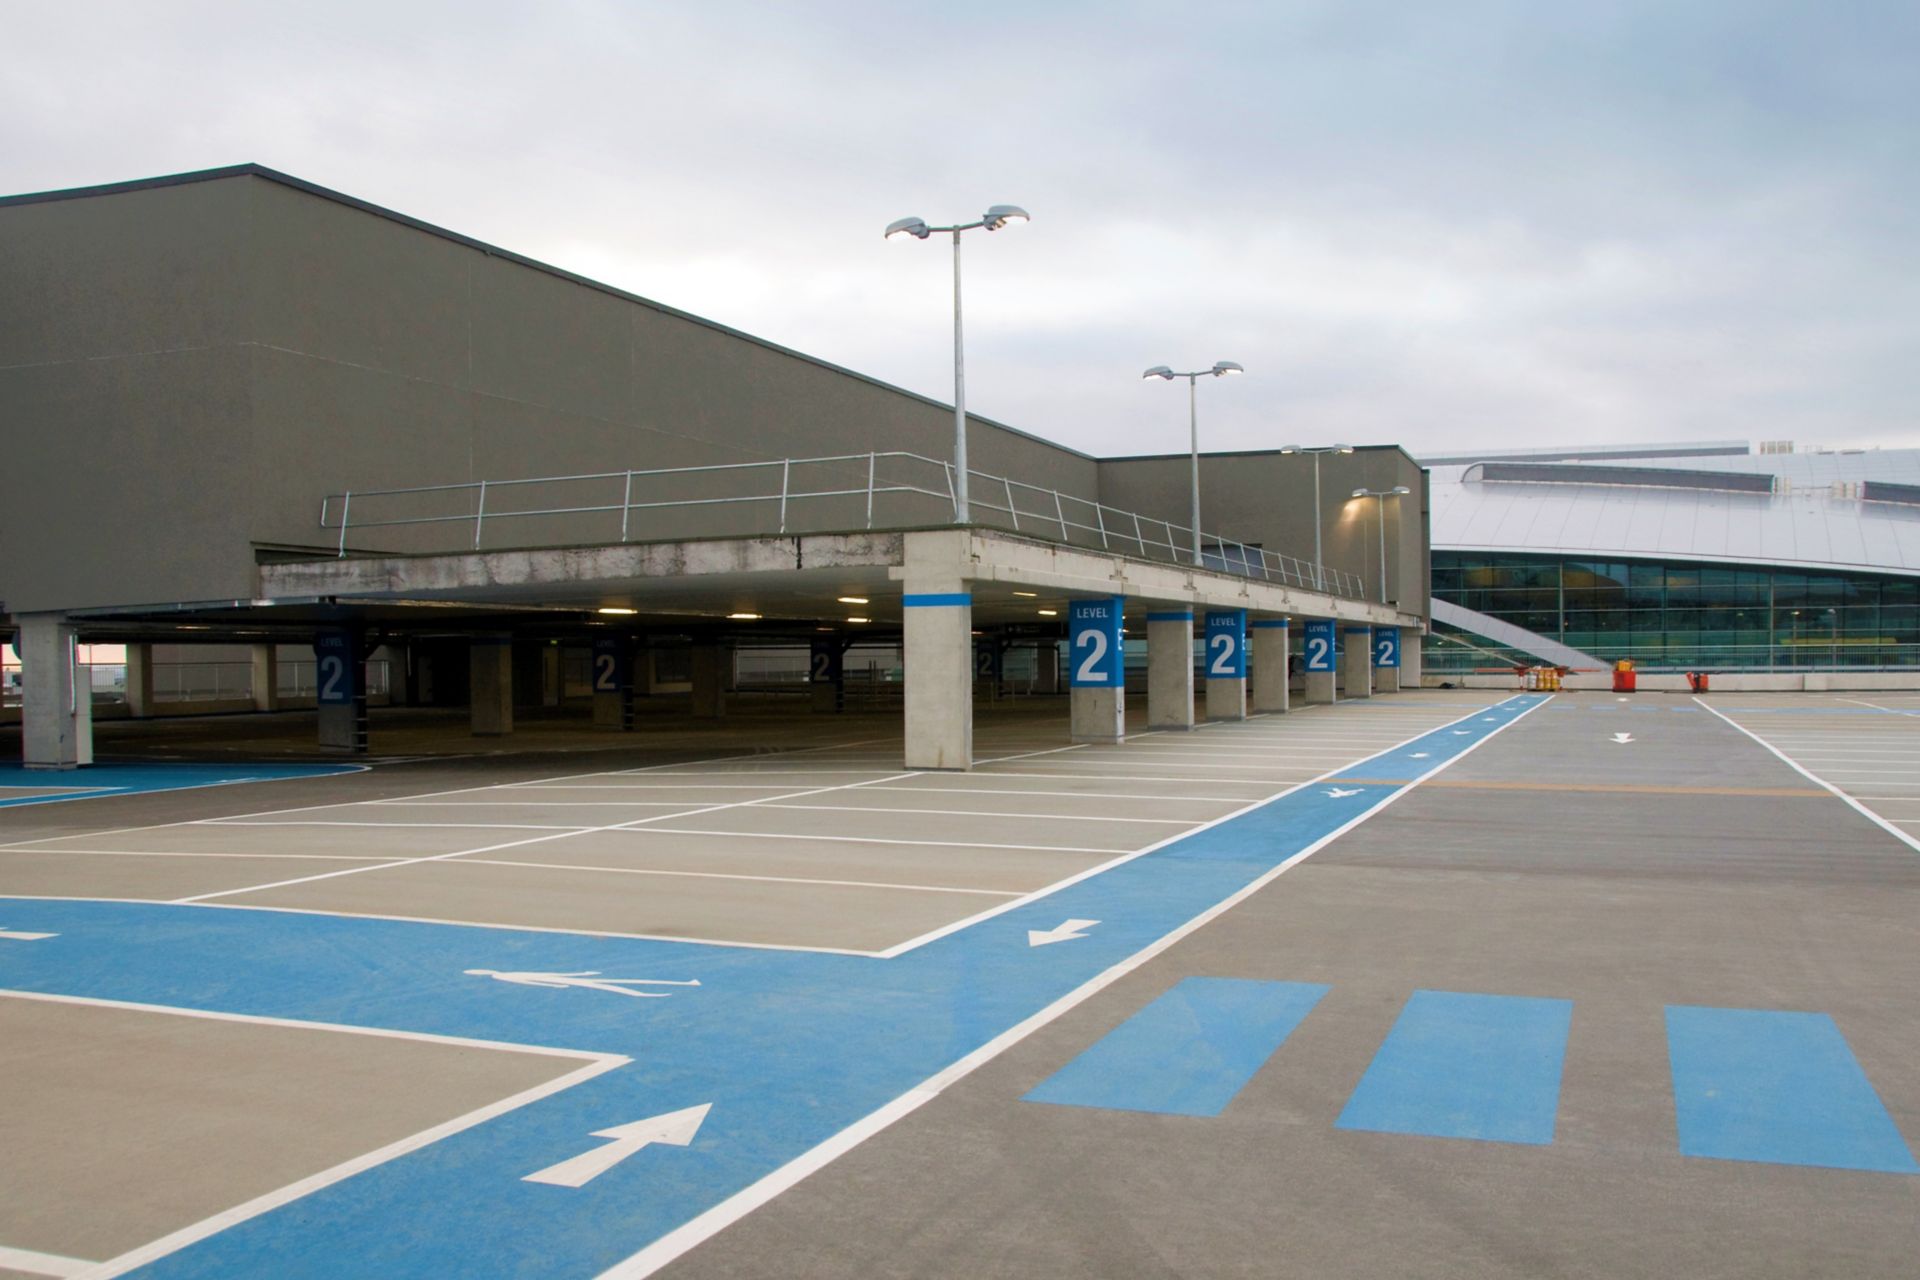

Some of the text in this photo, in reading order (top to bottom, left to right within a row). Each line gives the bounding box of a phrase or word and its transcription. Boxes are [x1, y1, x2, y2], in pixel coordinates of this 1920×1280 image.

[1077, 607, 1109, 619] LEVEL
[1210, 616, 1236, 626] LEVEL
[320, 636, 345, 648] LEVEL
[1308, 625, 1328, 633] LEVEL
[978, 652, 993, 676] 2
[1076, 629, 1108, 681] 2
[1211, 634, 1236, 674] 2
[1308, 638, 1328, 668] 2
[1378, 641, 1394, 665] 2
[320, 655, 344, 700] 2
[595, 654, 616, 690] 2
[812, 652, 830, 681] 2
